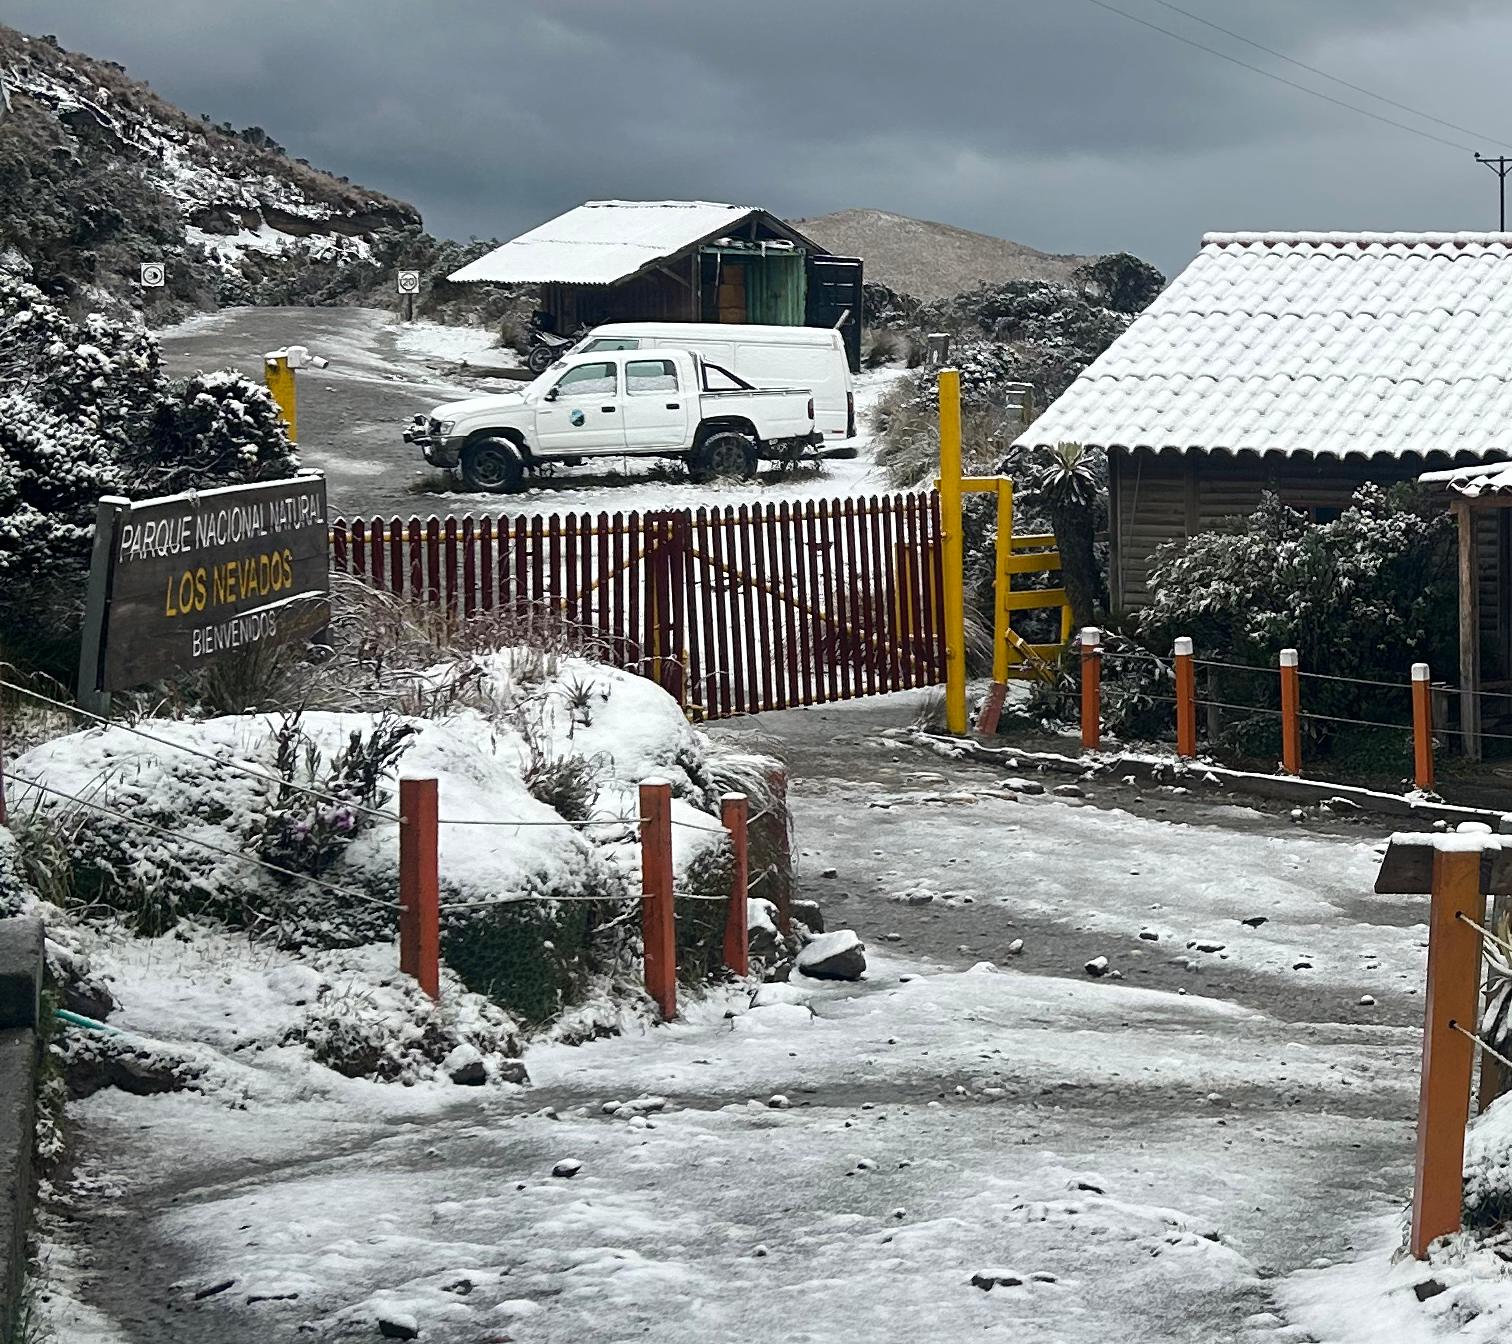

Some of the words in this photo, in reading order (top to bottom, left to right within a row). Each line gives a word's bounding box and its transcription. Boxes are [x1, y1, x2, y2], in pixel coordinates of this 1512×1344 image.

[119, 515, 192, 564] PARQUE
[195, 504, 267, 550] NACIONAL
[269, 494, 323, 533] NATURAL
[165, 567, 207, 617] LOS
[213, 549, 294, 605] NEVADOS
[192, 610, 277, 657] BIENVENIDOS
